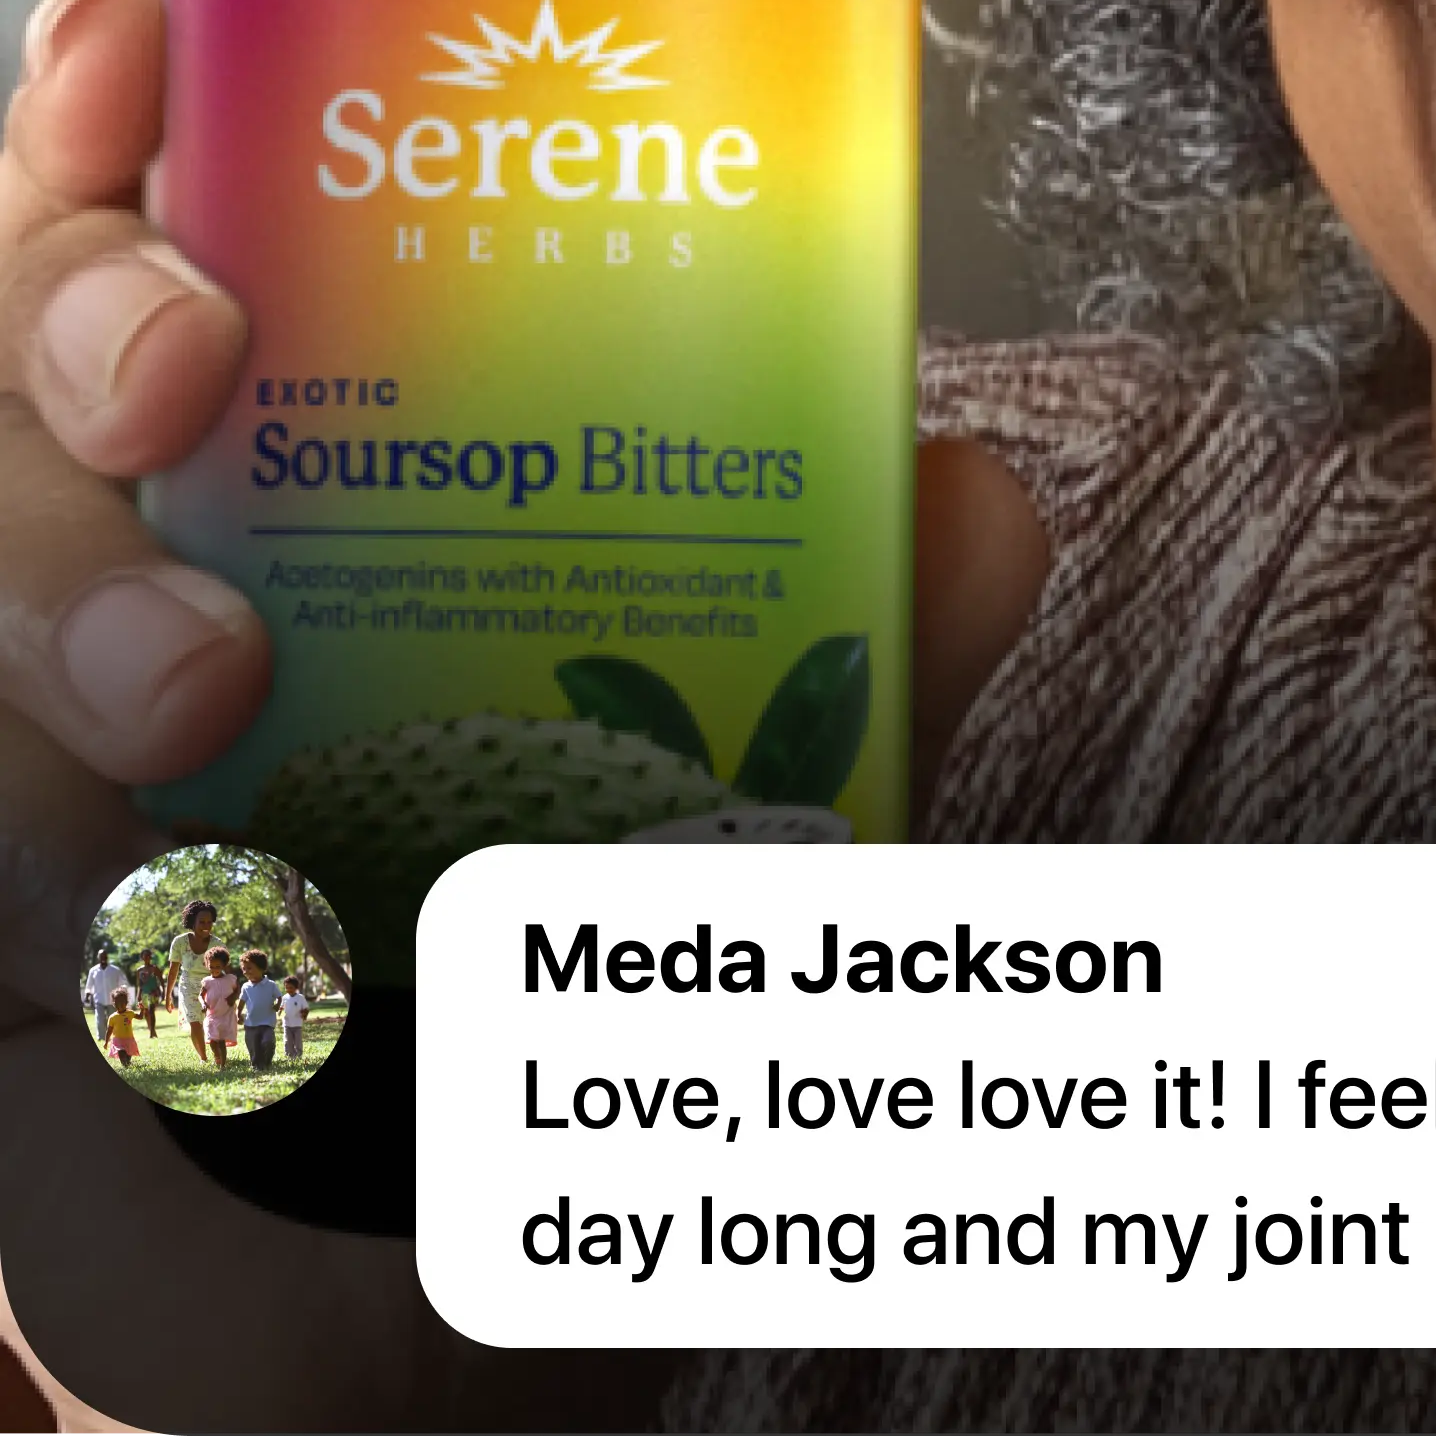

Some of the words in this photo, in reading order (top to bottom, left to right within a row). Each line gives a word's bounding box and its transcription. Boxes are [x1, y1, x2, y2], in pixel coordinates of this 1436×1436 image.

[318, 87, 760, 207] Serene
[394, 225, 695, 268] HERBS
[256, 378, 399, 407] EXOTIC
[251, 420, 559, 508] Soursop
[579, 423, 804, 500] Bitters
[265, 561, 467, 598] Acetogenins
[477, 562, 555, 593] with
[563, 564, 759, 598] Antioxidant
[762, 570, 786, 600] &
[292, 600, 611, 642] Anti-inflammatory
[623, 604, 759, 639] Benefits
